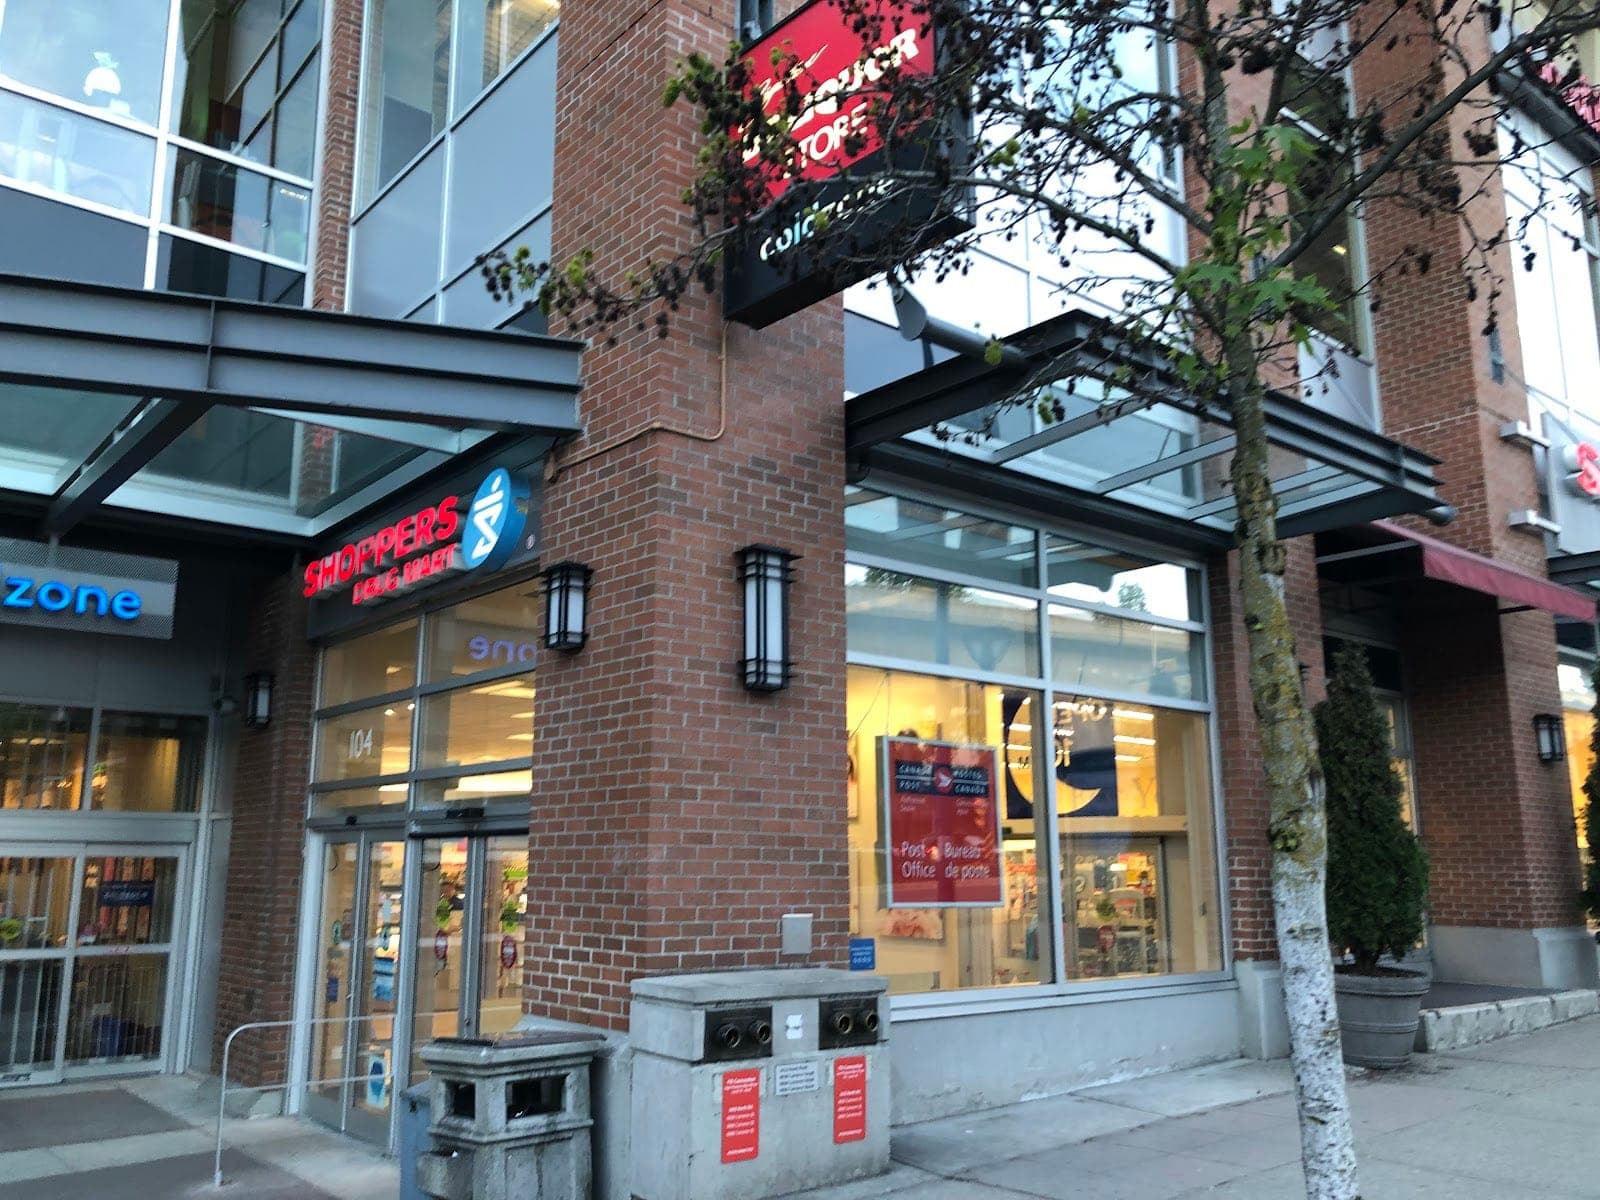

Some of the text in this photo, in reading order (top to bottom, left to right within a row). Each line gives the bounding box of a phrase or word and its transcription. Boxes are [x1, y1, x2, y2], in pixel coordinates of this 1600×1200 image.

[303, 495, 459, 598] SHOPPERS
[404, 545, 456, 585] MART
[349, 728, 373, 758] 104
[902, 841, 926, 858] Post
[945, 842, 981, 859] Bureau
[902, 862, 936, 878] Office
[945, 862, 991, 881] de poste
